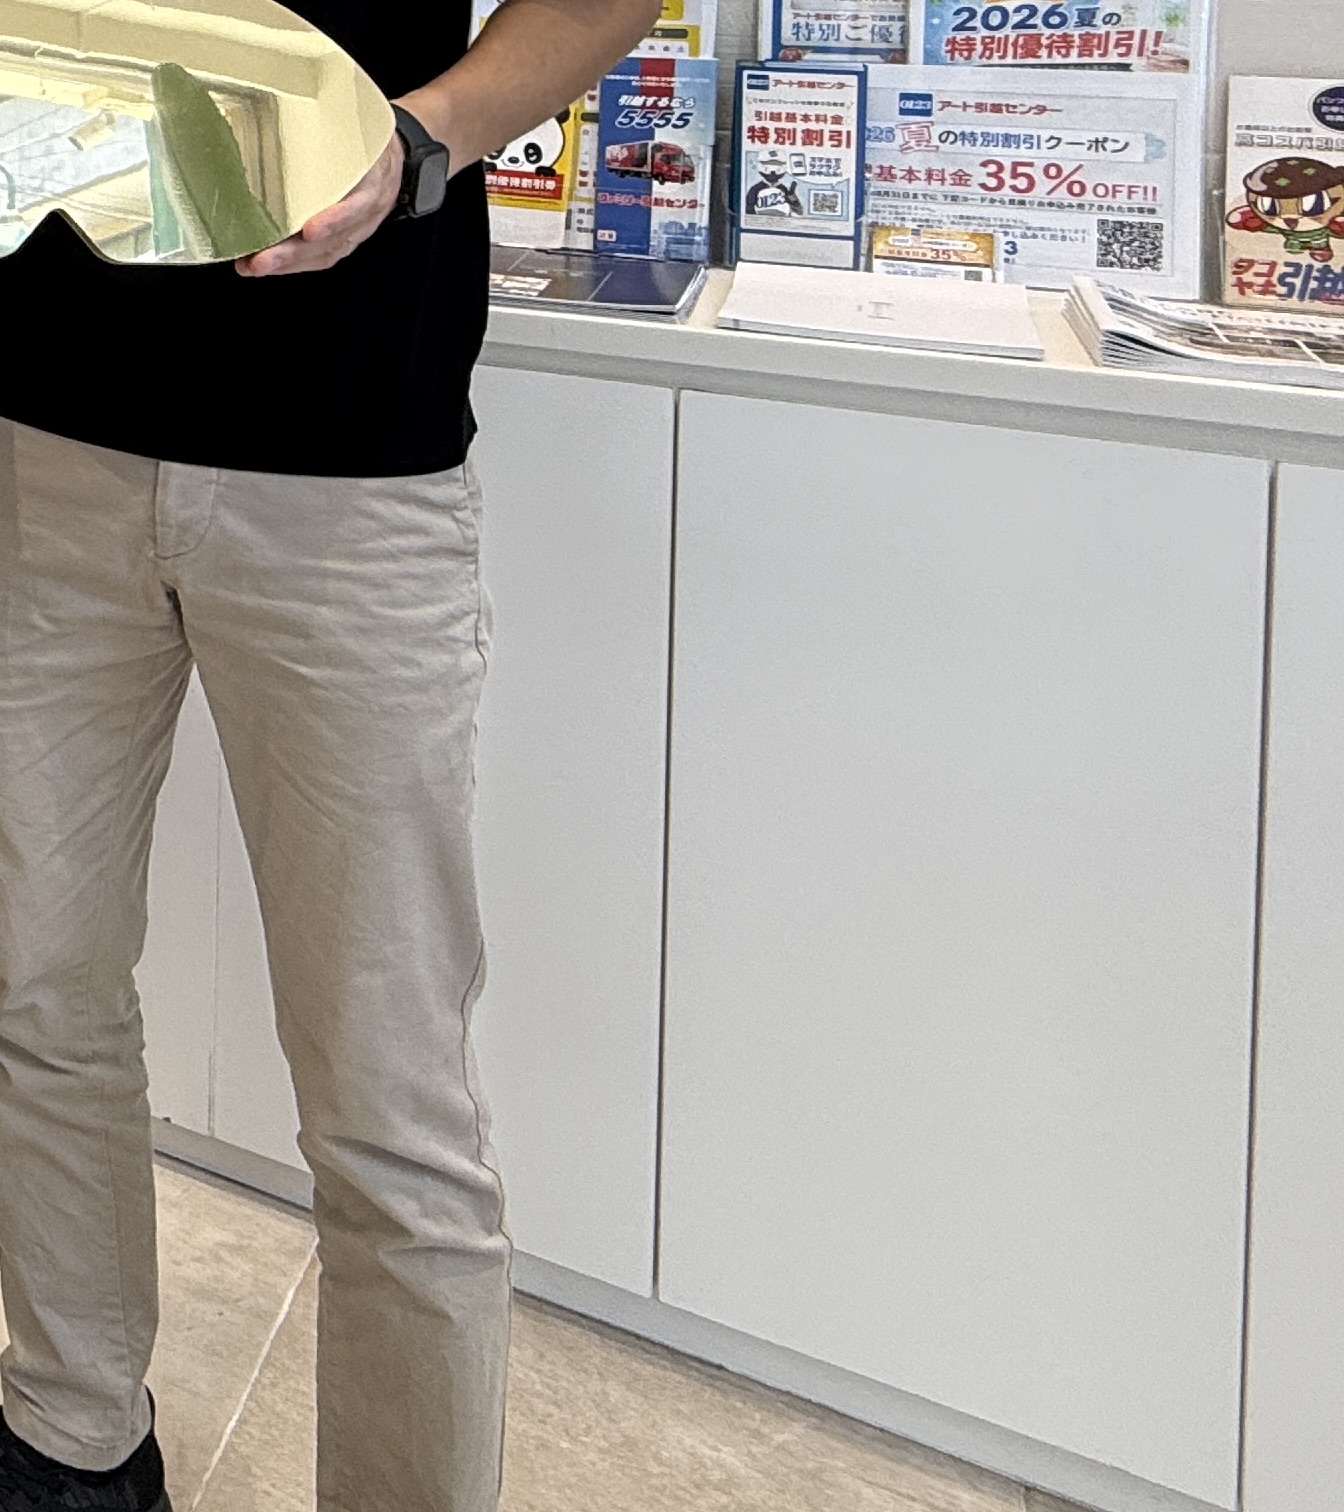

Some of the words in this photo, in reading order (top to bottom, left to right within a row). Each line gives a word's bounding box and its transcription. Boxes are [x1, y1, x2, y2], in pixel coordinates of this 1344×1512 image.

[944, 28, 1164, 62] 特別優待割引!
[614, 109, 694, 130] 5555
[746, 124, 852, 150] 特別割引
[1231, 258, 1278, 276] タコ
